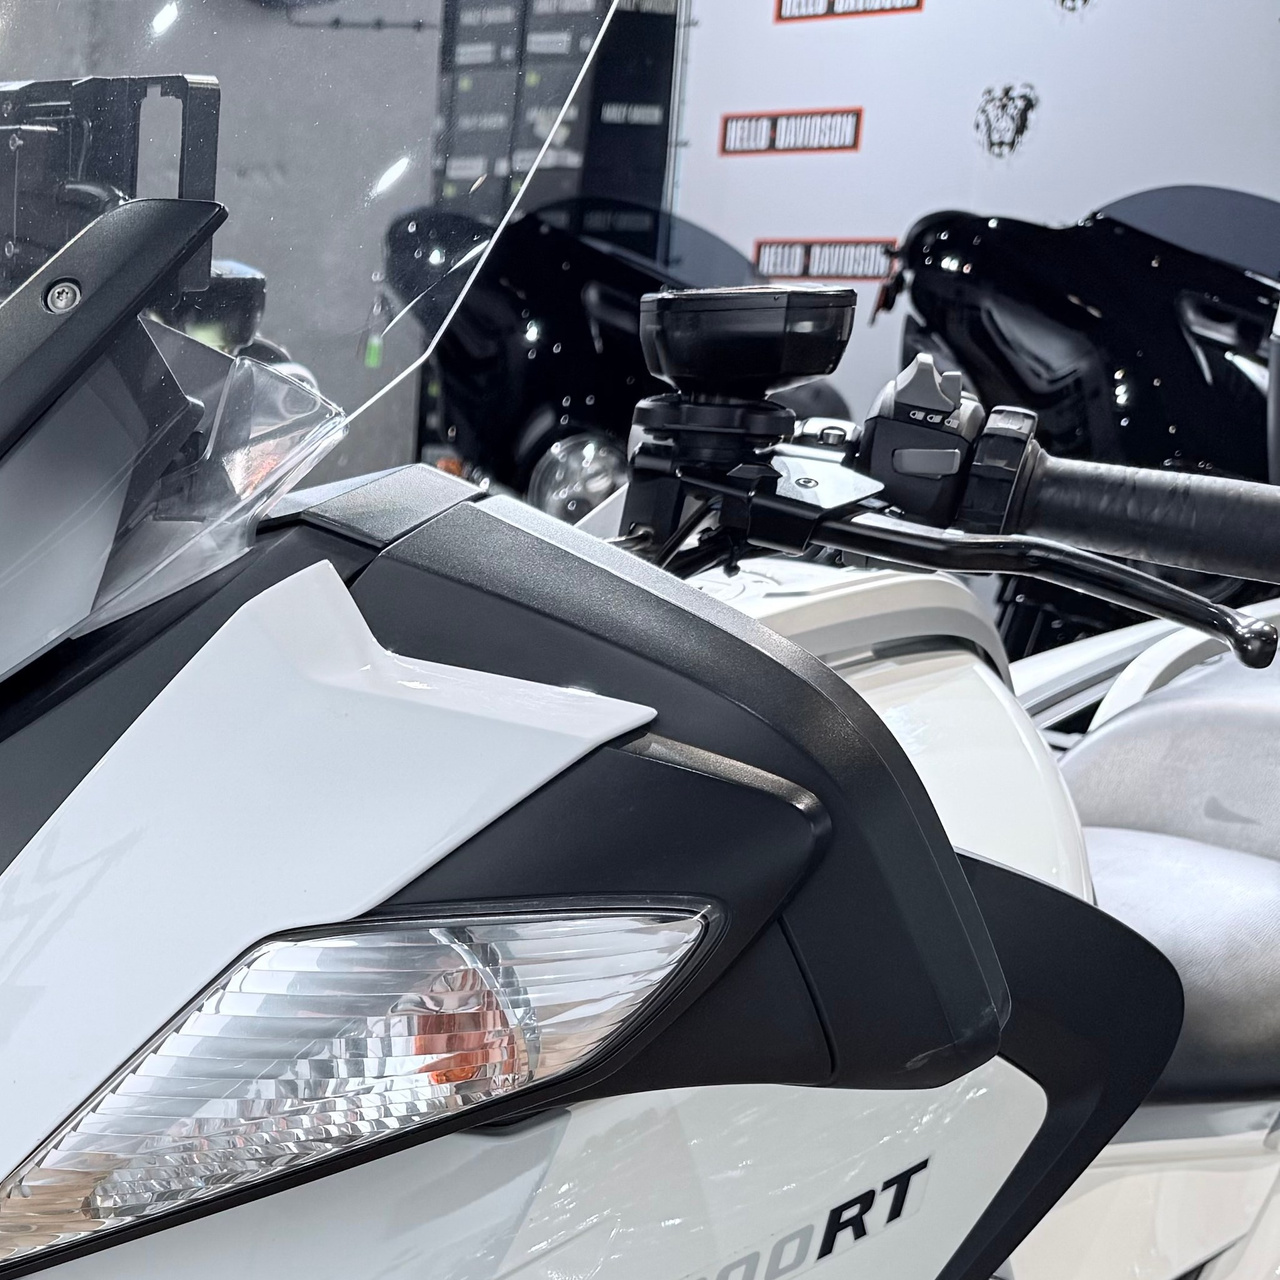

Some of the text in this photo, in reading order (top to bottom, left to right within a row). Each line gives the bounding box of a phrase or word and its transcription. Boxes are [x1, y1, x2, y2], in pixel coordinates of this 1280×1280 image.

[725, 112, 857, 152] HELLO DAVIDSON
[759, 244, 804, 276] HELLO
